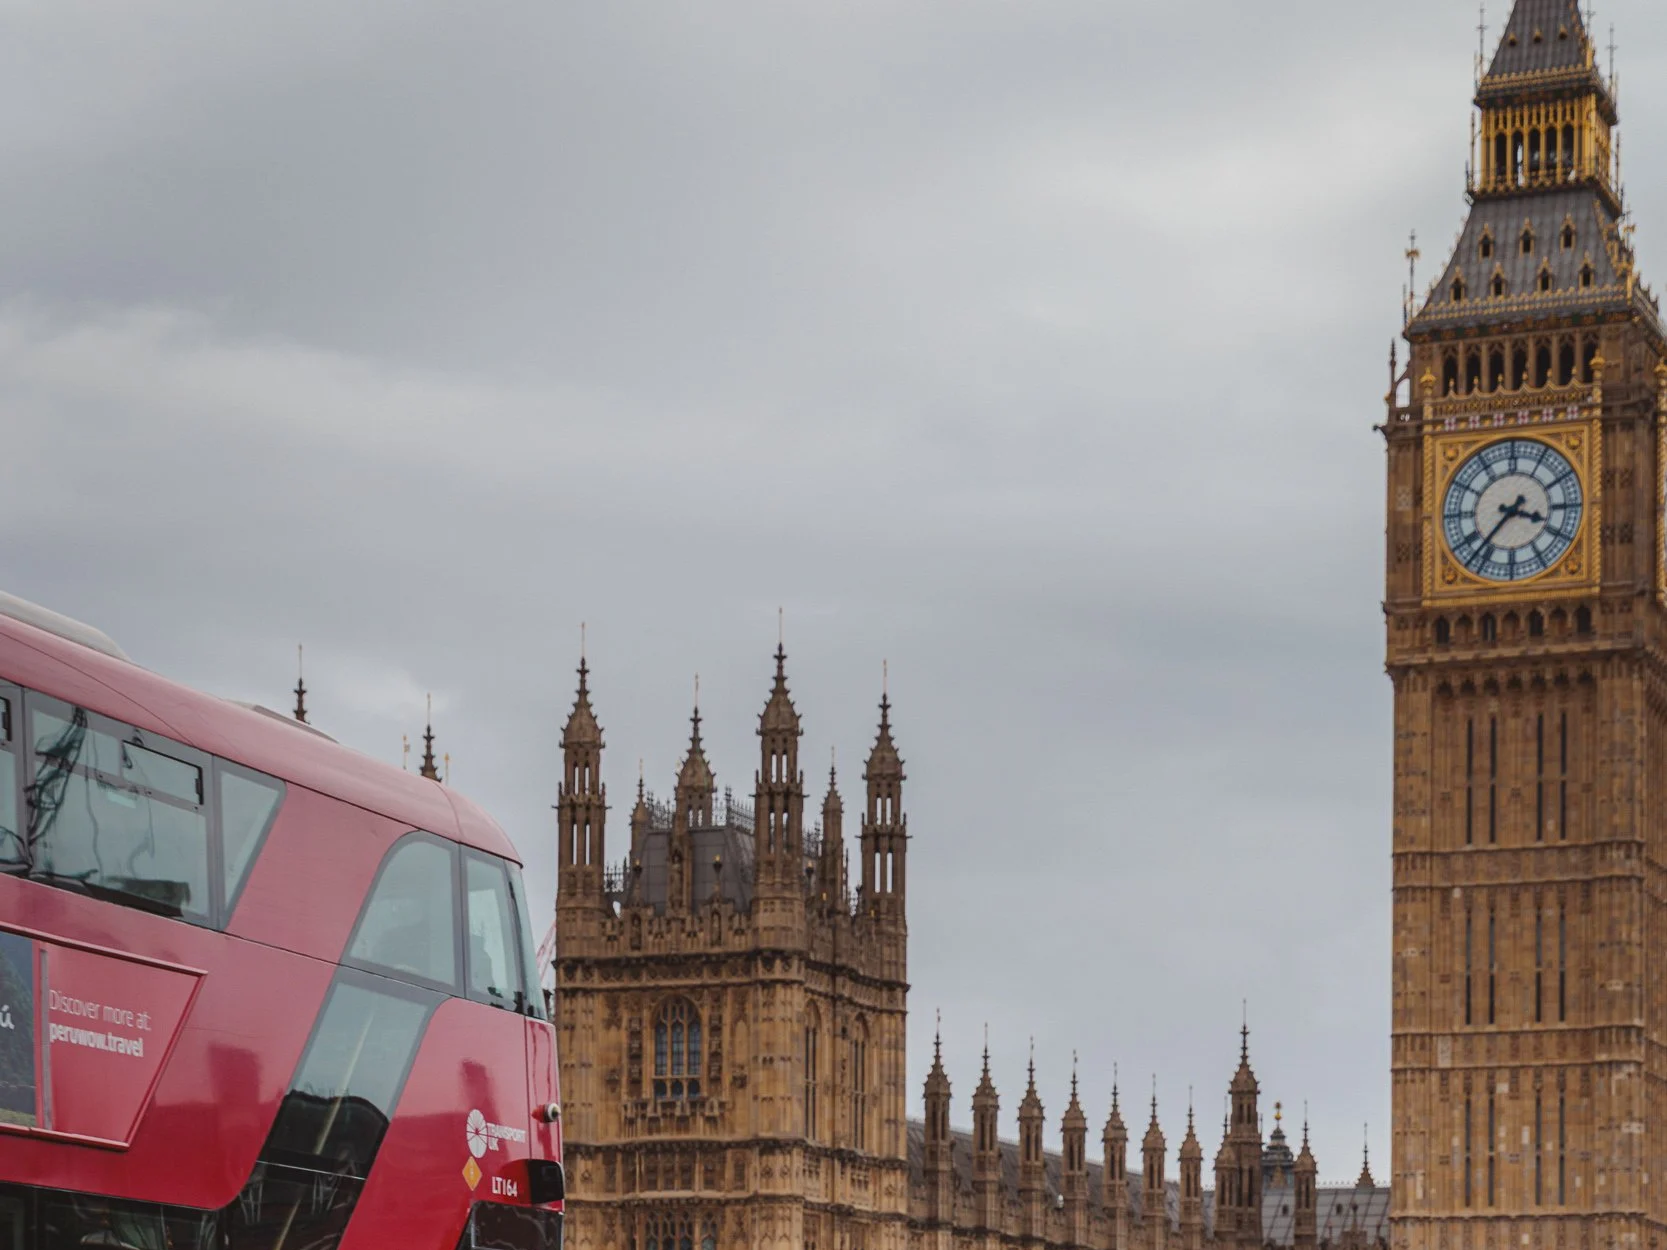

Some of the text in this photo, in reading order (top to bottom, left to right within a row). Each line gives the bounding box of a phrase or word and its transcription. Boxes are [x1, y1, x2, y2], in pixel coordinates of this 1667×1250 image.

[49, 989, 100, 1020] Discover
[103, 1005, 133, 1027] more
[49, 1022, 144, 1057] peruwow.travel
[491, 1176, 518, 1197] LT164
